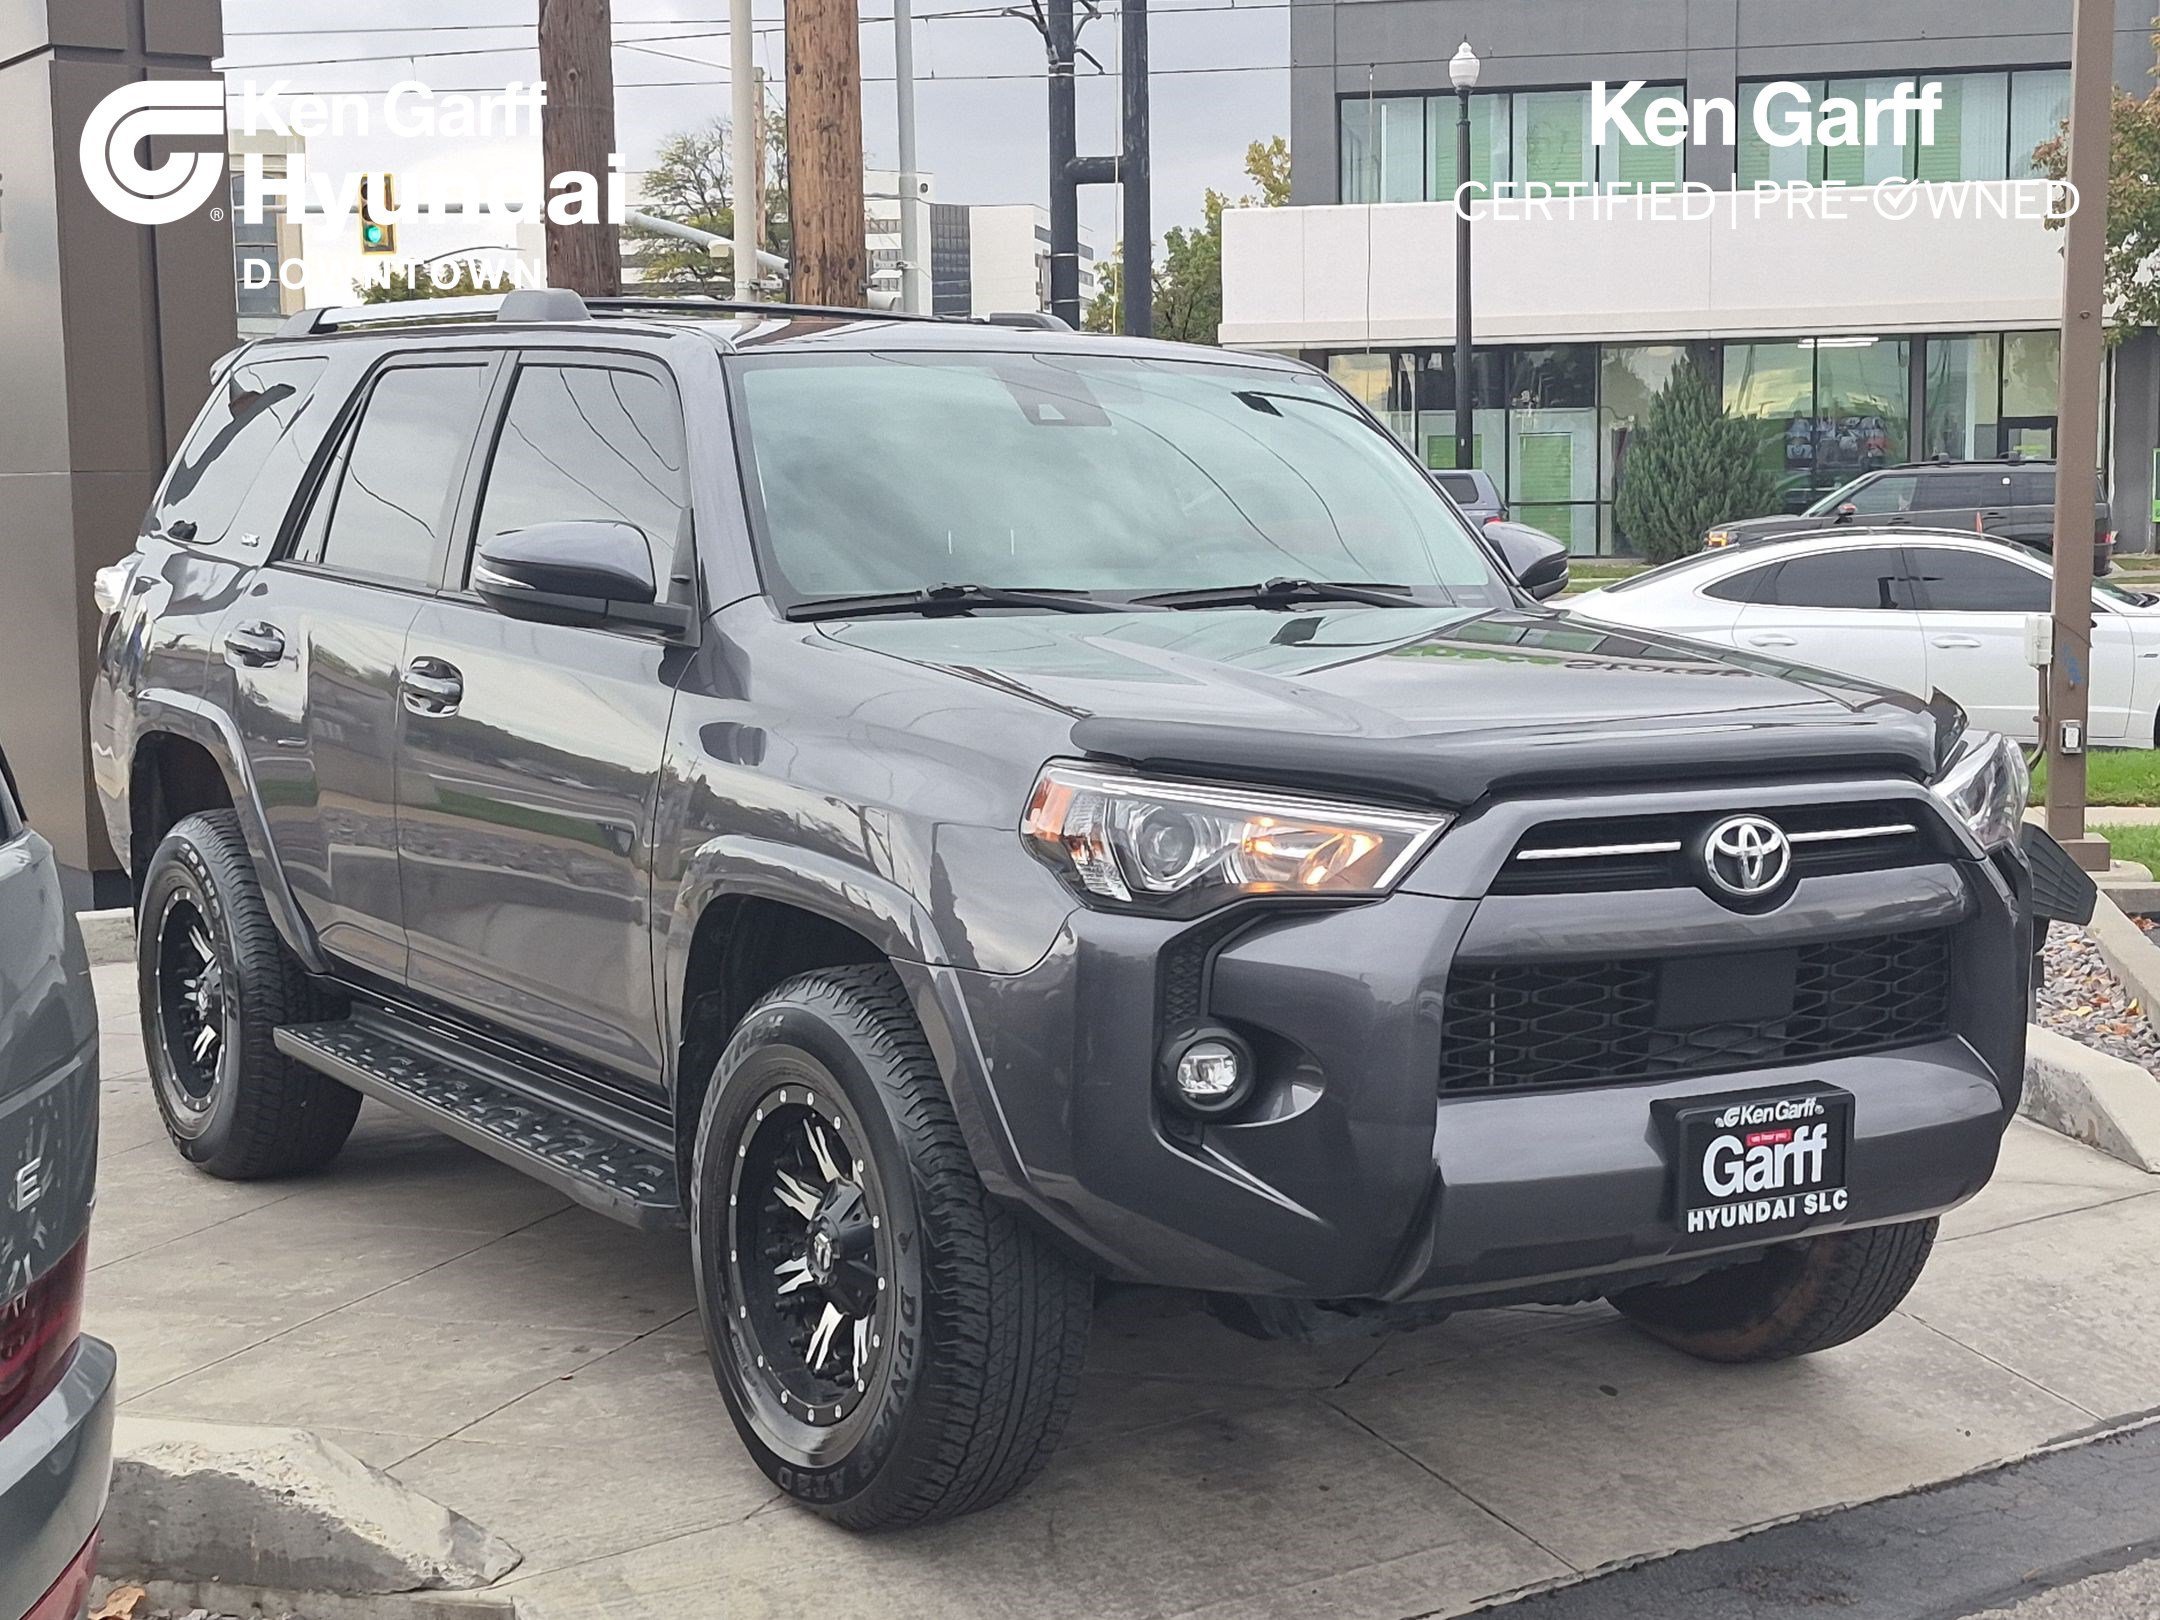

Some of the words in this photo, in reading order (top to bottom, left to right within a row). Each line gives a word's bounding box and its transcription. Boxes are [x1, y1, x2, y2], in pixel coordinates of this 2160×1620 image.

[1740, 1105, 1774, 1126] Ken
[1775, 1098, 1817, 1121] Garff
[1702, 1123, 1828, 1197] Garff
[1687, 1197, 1795, 1233] HYUNDAI
[1803, 1189, 1848, 1216] SLC
